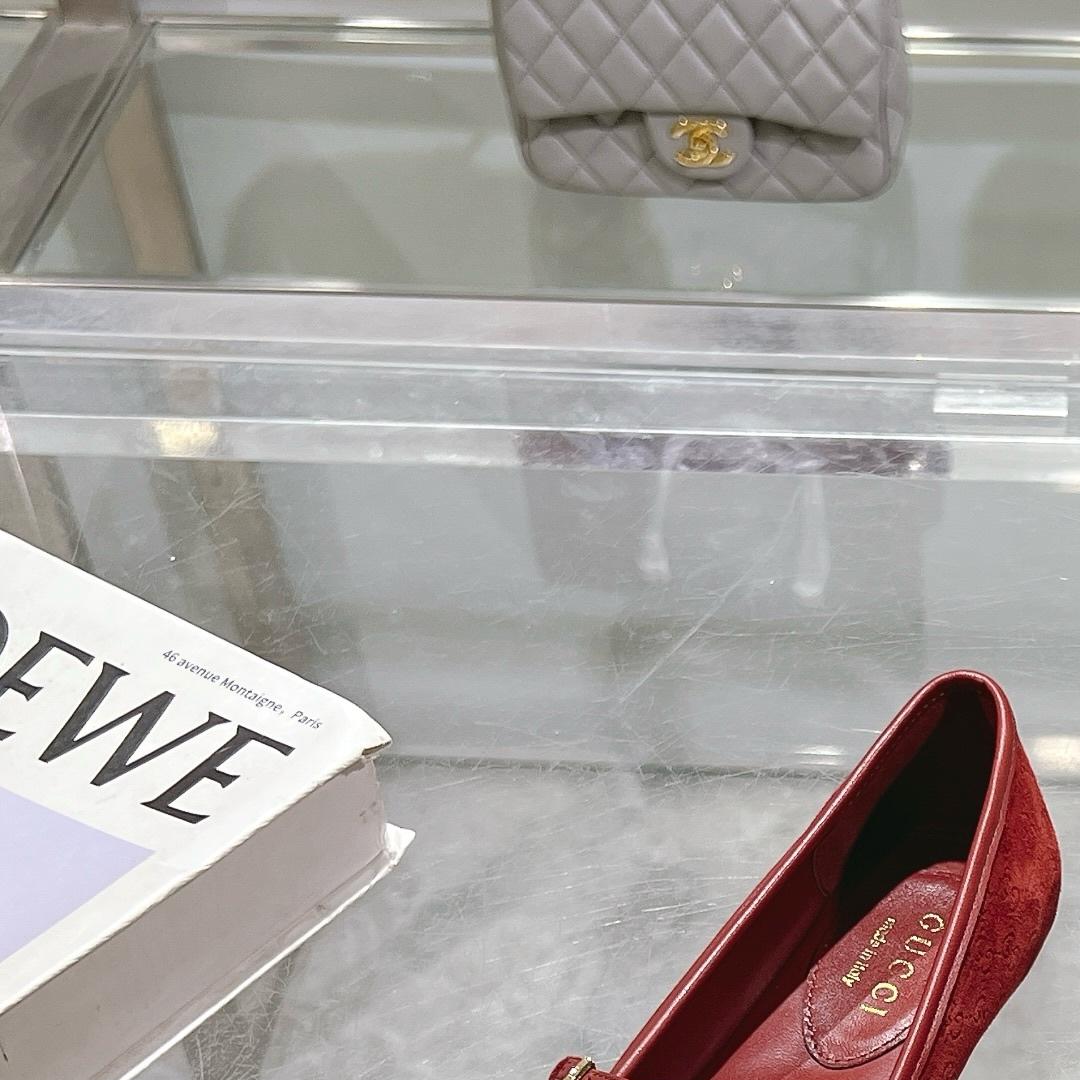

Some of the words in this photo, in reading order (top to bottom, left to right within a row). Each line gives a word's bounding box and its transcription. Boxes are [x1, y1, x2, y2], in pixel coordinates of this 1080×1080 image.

[0, 610, 296, 824] EWE
[162, 650, 180, 663] 46
[177, 658, 221, 683] avenue
[290, 710, 324, 729] Paris
[860, 912, 945, 1017] GUCCI
